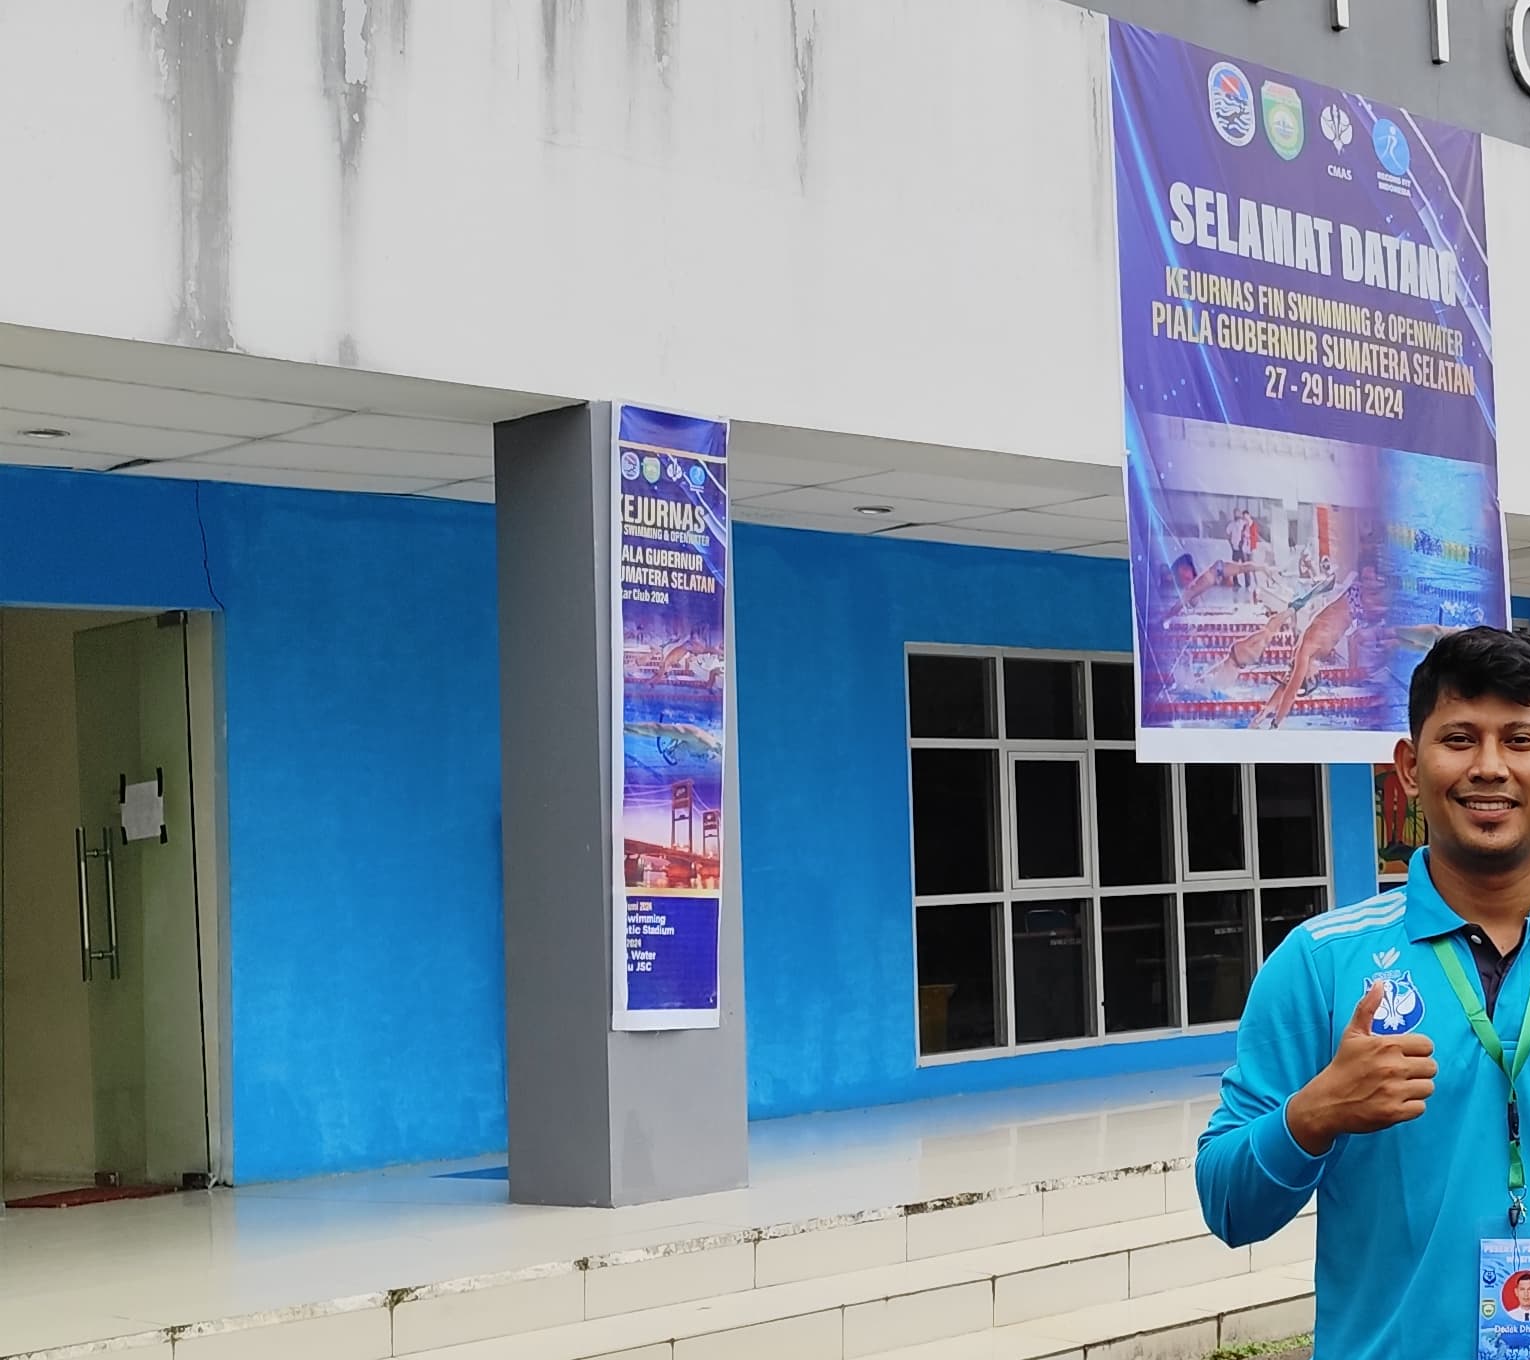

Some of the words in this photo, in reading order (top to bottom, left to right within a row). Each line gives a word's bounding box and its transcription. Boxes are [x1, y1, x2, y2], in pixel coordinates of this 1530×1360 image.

[1327, 165, 1352, 180] CMAS
[1169, 182, 1333, 276] SELAMAT
[1340, 224, 1458, 308] DATANG
[1165, 266, 1254, 313] KEJURNAS
[1259, 285, 1285, 318] FIN
[1288, 292, 1371, 337] SWIMMING
[1374, 310, 1386, 337] &
[1388, 312, 1463, 358] OPENWATER
[1152, 301, 1213, 348] PIALA
[1217, 314, 1318, 366] GUBERNUR
[1322, 332, 1410, 385] SUMATERA
[1413, 352, 1475, 397] SELATAN
[1264, 365, 1286, 400] 27
[1301, 374, 1323, 406] 29
[1326, 377, 1361, 412] Juni
[1364, 383, 1403, 420] 2024
[624, 524, 662, 540] SWIMMING
[645, 547, 703, 572] GUBERNUR
[671, 570, 715, 594] SELATAN
[633, 588, 650, 602] Club
[651, 590, 669, 604] 2024
[643, 925, 675, 936] Stadium
